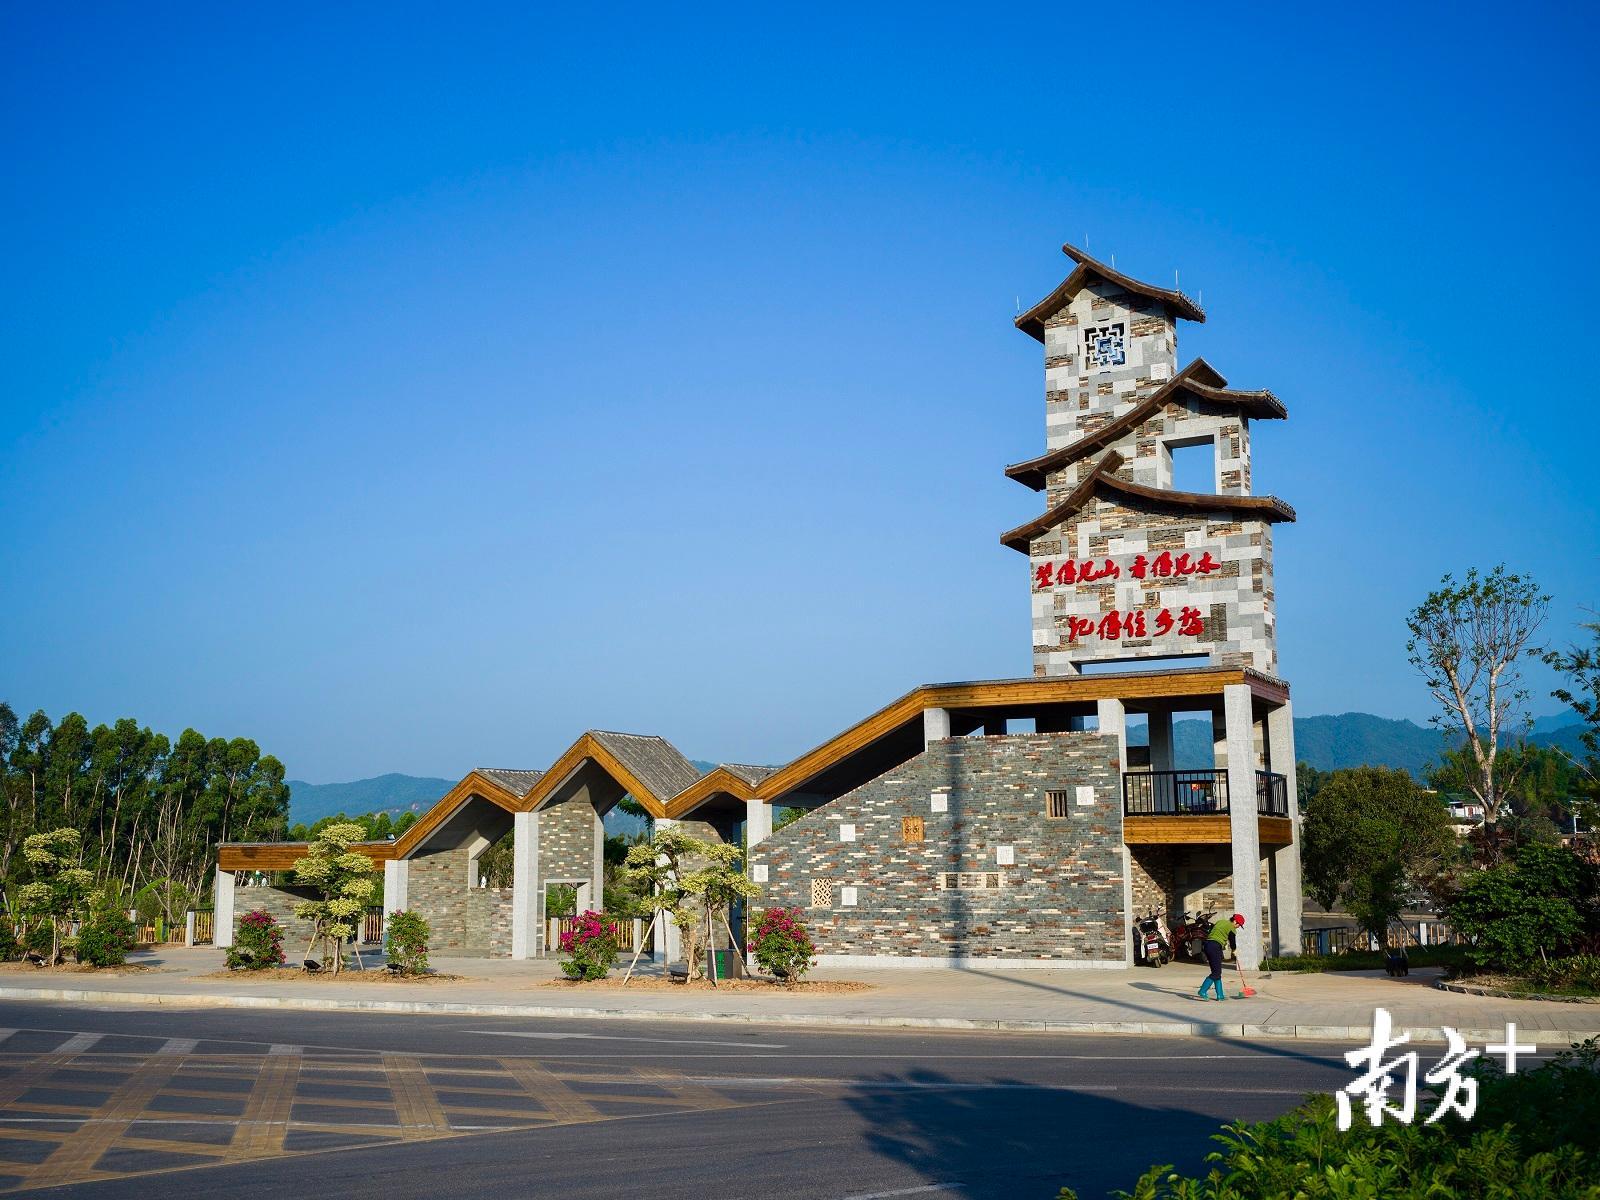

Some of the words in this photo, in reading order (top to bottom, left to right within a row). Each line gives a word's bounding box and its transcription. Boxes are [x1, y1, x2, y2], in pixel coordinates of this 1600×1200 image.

[1035, 559, 1120, 588] 望得见山
[1128, 551, 1221, 580] 看得见水
[1068, 606, 1205, 643] 记得住乡愁
